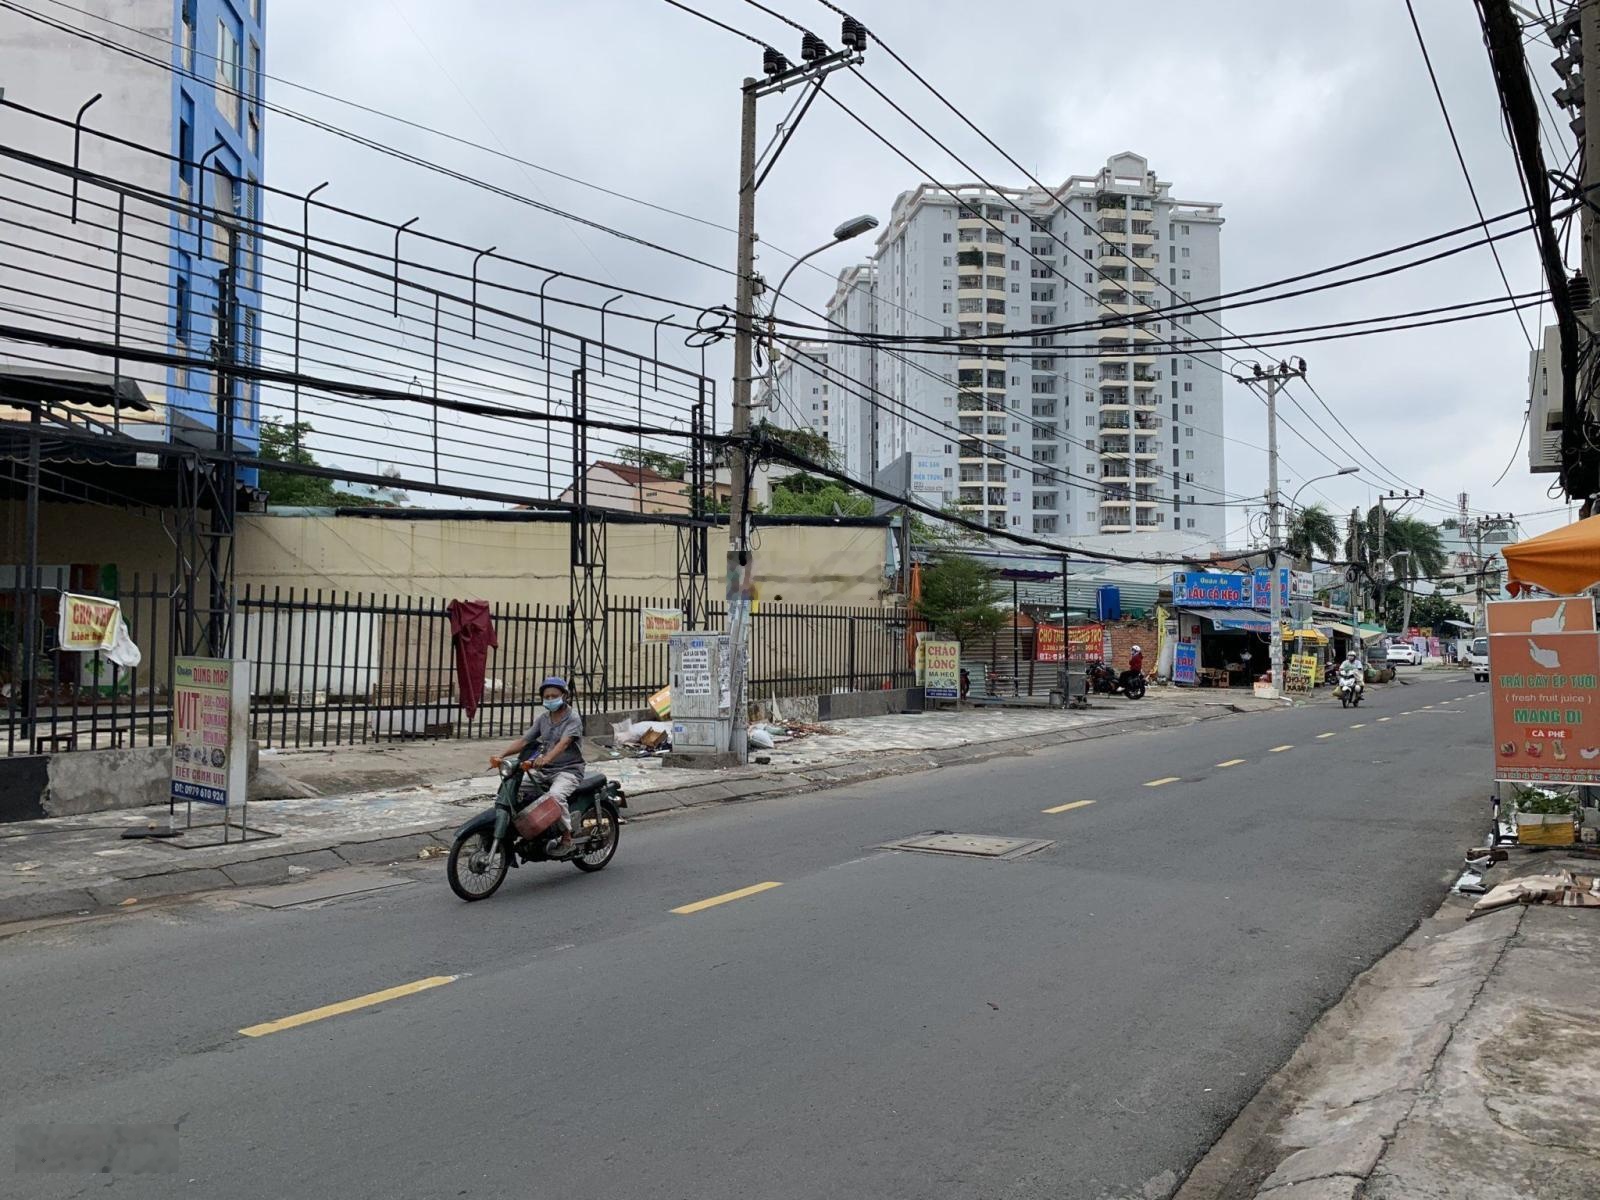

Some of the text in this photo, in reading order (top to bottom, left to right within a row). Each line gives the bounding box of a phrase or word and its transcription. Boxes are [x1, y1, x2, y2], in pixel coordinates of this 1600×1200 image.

[1499, 672, 1524, 688] TRÁI
[1527, 672, 1549, 688] CÂY
[1551, 672, 1567, 688] ÉP
[1511, 694, 1537, 702] fresh
[1539, 694, 1558, 702] fruit
[1560, 694, 1585, 704] juice
[177, 691, 200, 736] VỊT
[1513, 708, 1583, 725] MANG ĐI
[184, 785, 200, 797] 0979
[200, 788, 212, 799] 610
[212, 791, 225, 803] 924
